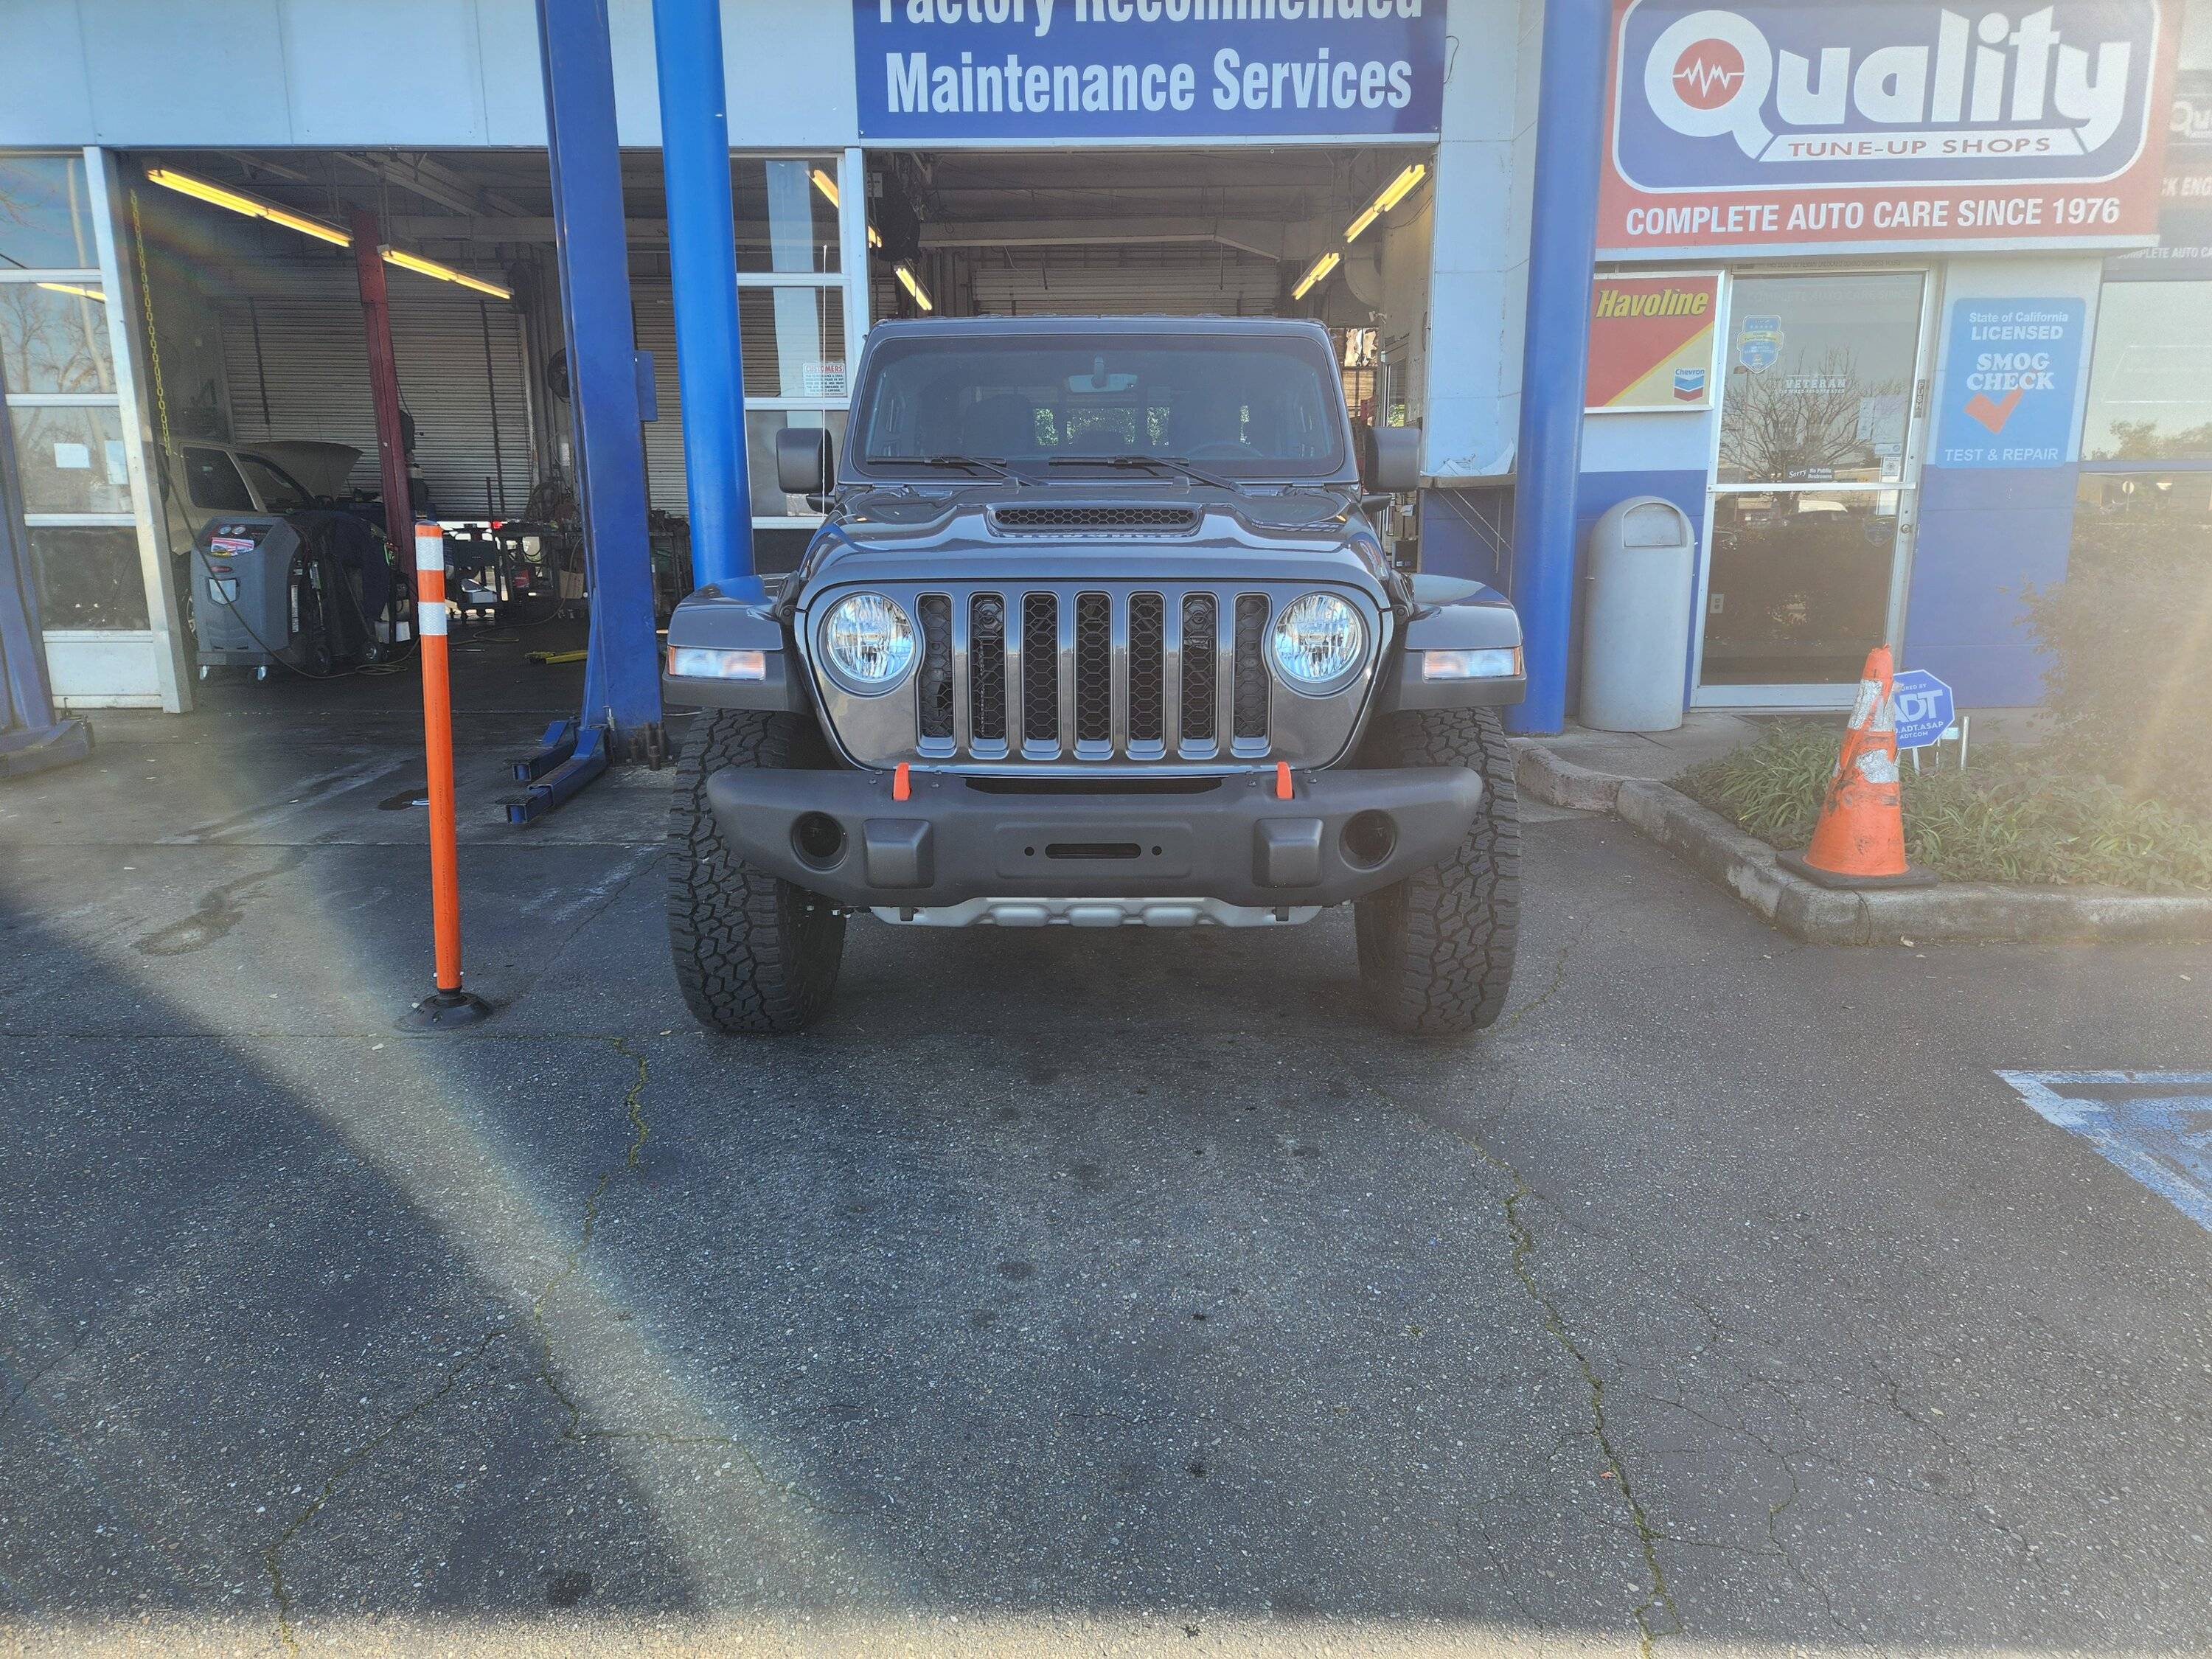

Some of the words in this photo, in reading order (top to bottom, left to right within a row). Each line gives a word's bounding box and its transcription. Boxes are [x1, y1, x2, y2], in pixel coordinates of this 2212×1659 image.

[886, 52, 1195, 113] Maintenance
[1213, 47, 1412, 109] Services
[1644, 6, 2131, 161] Quality
[1788, 140, 1927, 157] TUNE-UP
[1942, 137, 2051, 154] SHOPS
[1626, 205, 1778, 235] COMPLETE
[1787, 202, 1867, 231] AUTO
[1874, 200, 1949, 229] CARE
[1958, 198, 2040, 226] SINCE
[2052, 197, 2120, 225] 1976
[2118, 247, 2170, 259] PLETE
[1596, 288, 1710, 318] Havoline
[1969, 313, 1999, 323] State
[2002, 312, 2014, 322] of
[2015, 311, 2069, 322] California
[1971, 325, 2063, 341] LICENSED
[1976, 352, 2051, 371] SMOG
[1786, 378, 1846, 389] VETERAN
[1966, 372, 2055, 391] CHECK
[1916, 382, 1924, 409] PUSH
[1945, 448, 1983, 461] TEST
[1987, 449, 1998, 461] &
[2003, 448, 2059, 461] REPAIR
[1788, 470, 1807, 479] Sorry
[1899, 731, 1928, 740] ADT.COM
